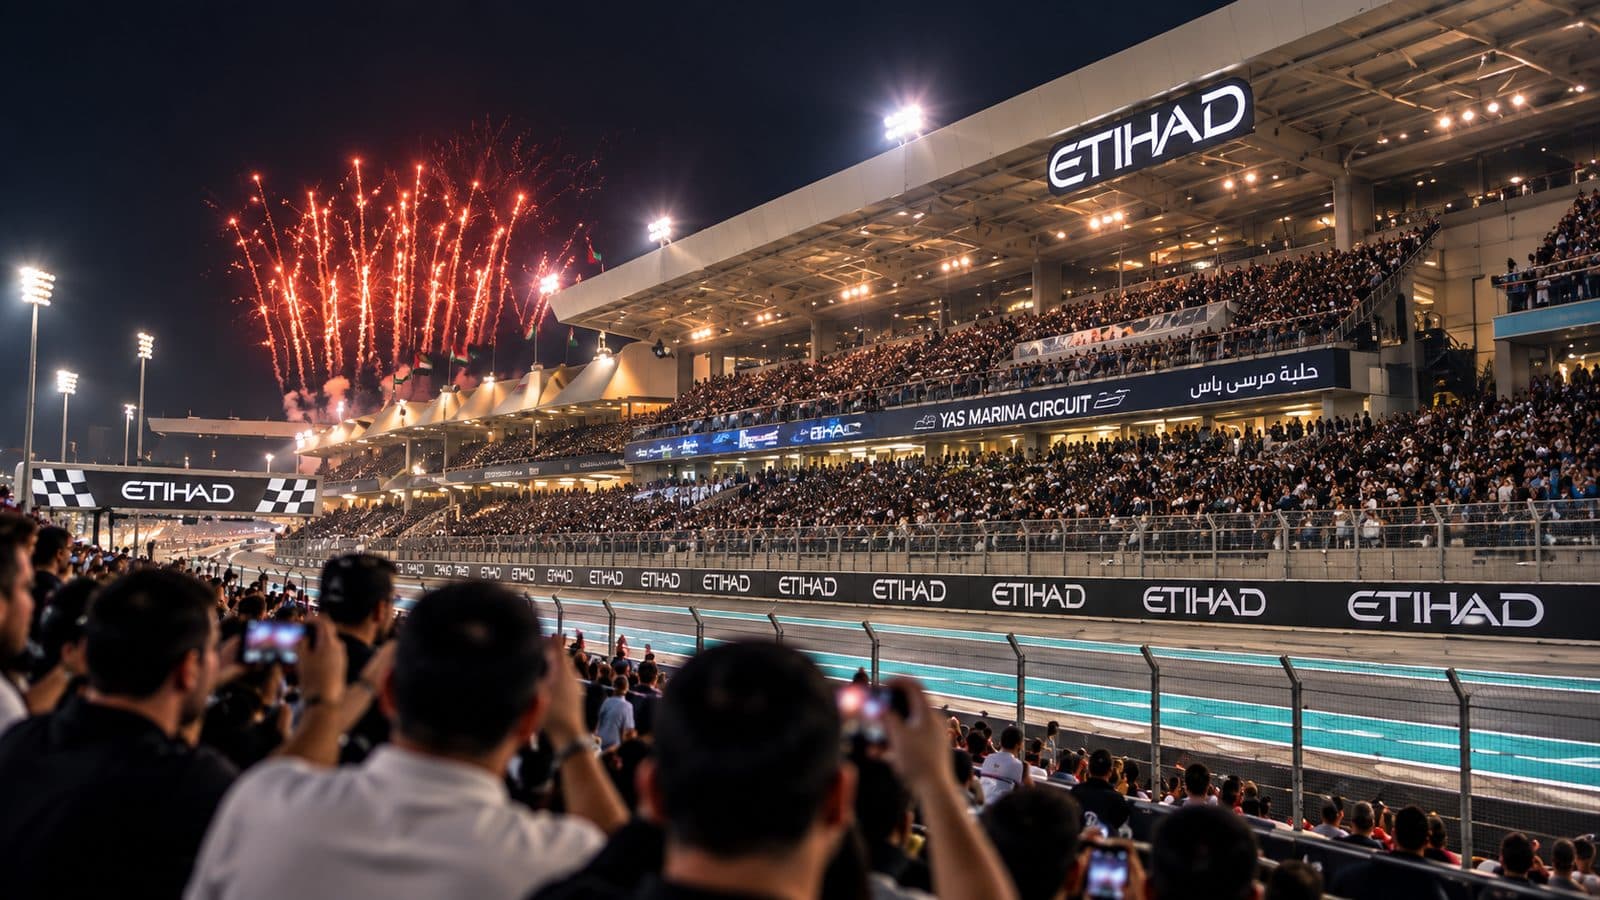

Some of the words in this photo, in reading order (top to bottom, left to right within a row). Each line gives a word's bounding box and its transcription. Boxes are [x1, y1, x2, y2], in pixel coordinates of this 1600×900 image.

[1049, 84, 1246, 188] ETIHAD
[1226, 371, 1276, 394] مرسى
[939, 410, 966, 429] YAS
[968, 401, 1026, 425] MARINA
[1029, 395, 1092, 419] CIRCUIT
[122, 481, 234, 503] ETIHAD
[641, 572, 680, 588] ETIHAD
[703, 574, 750, 592] ETIHAD
[779, 576, 837, 596] ETIHAD
[873, 579, 946, 601] ETIHAD
[992, 583, 1085, 608] ETIHAD
[1143, 587, 1265, 616] ETIHAD
[1348, 591, 1544, 626] ETIHAD
